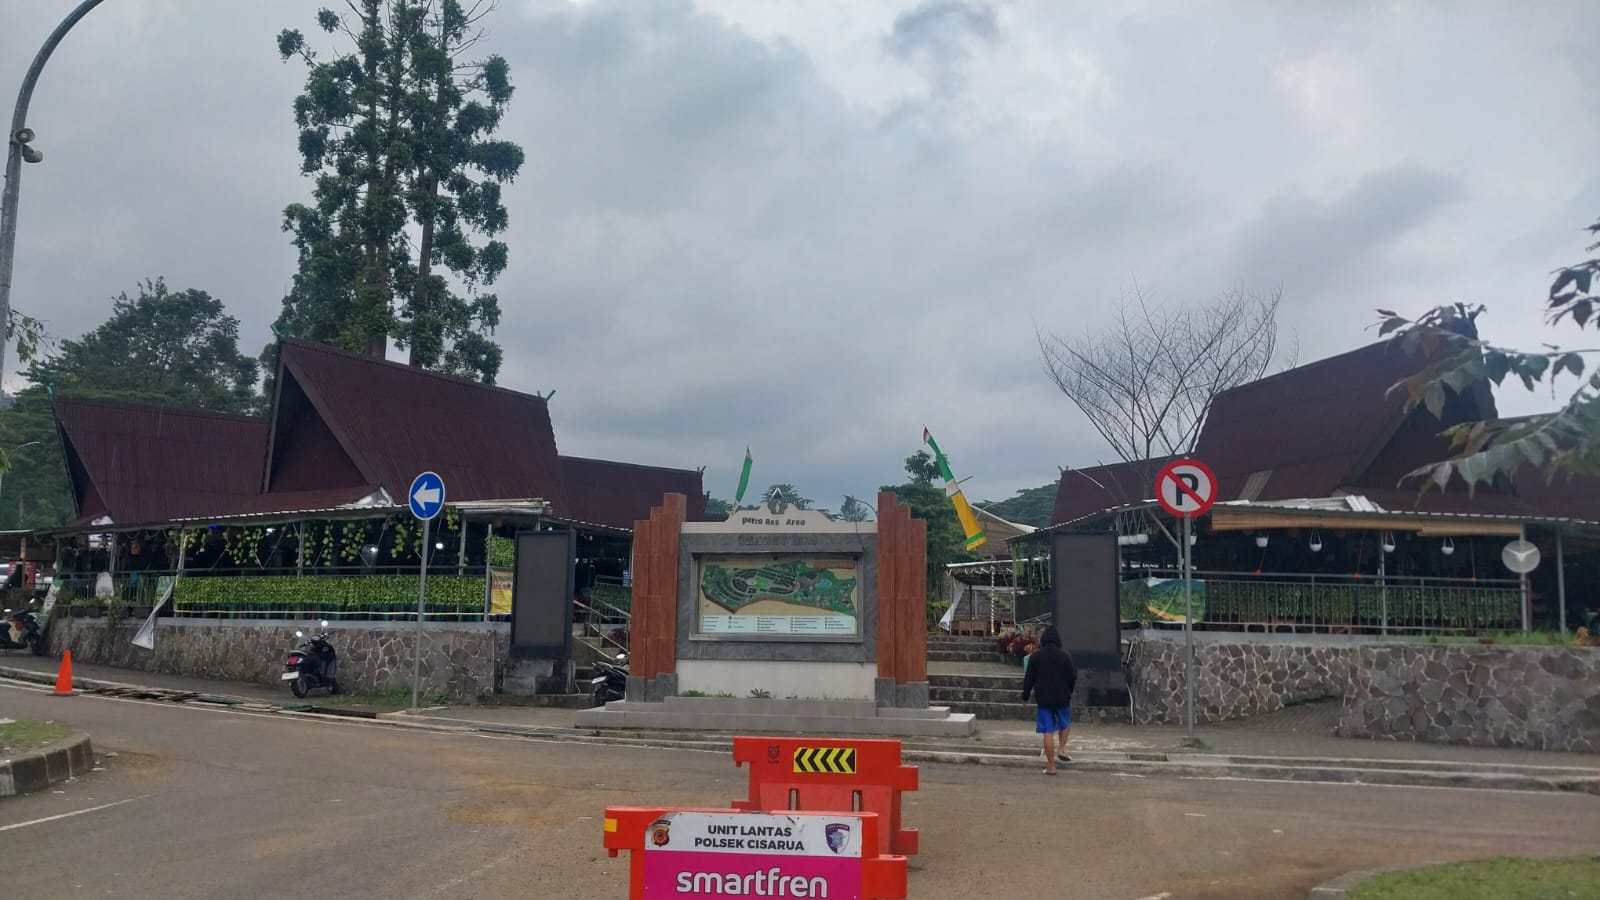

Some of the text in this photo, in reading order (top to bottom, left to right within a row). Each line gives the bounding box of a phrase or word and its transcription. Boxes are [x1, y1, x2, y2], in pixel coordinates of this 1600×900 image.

[1176, 473, 1198, 506] P
[708, 825, 792, 837] UNIT LANTAS
[694, 837, 804, 851] POLSEK CISARUA
[676, 867, 828, 899] smartfren
